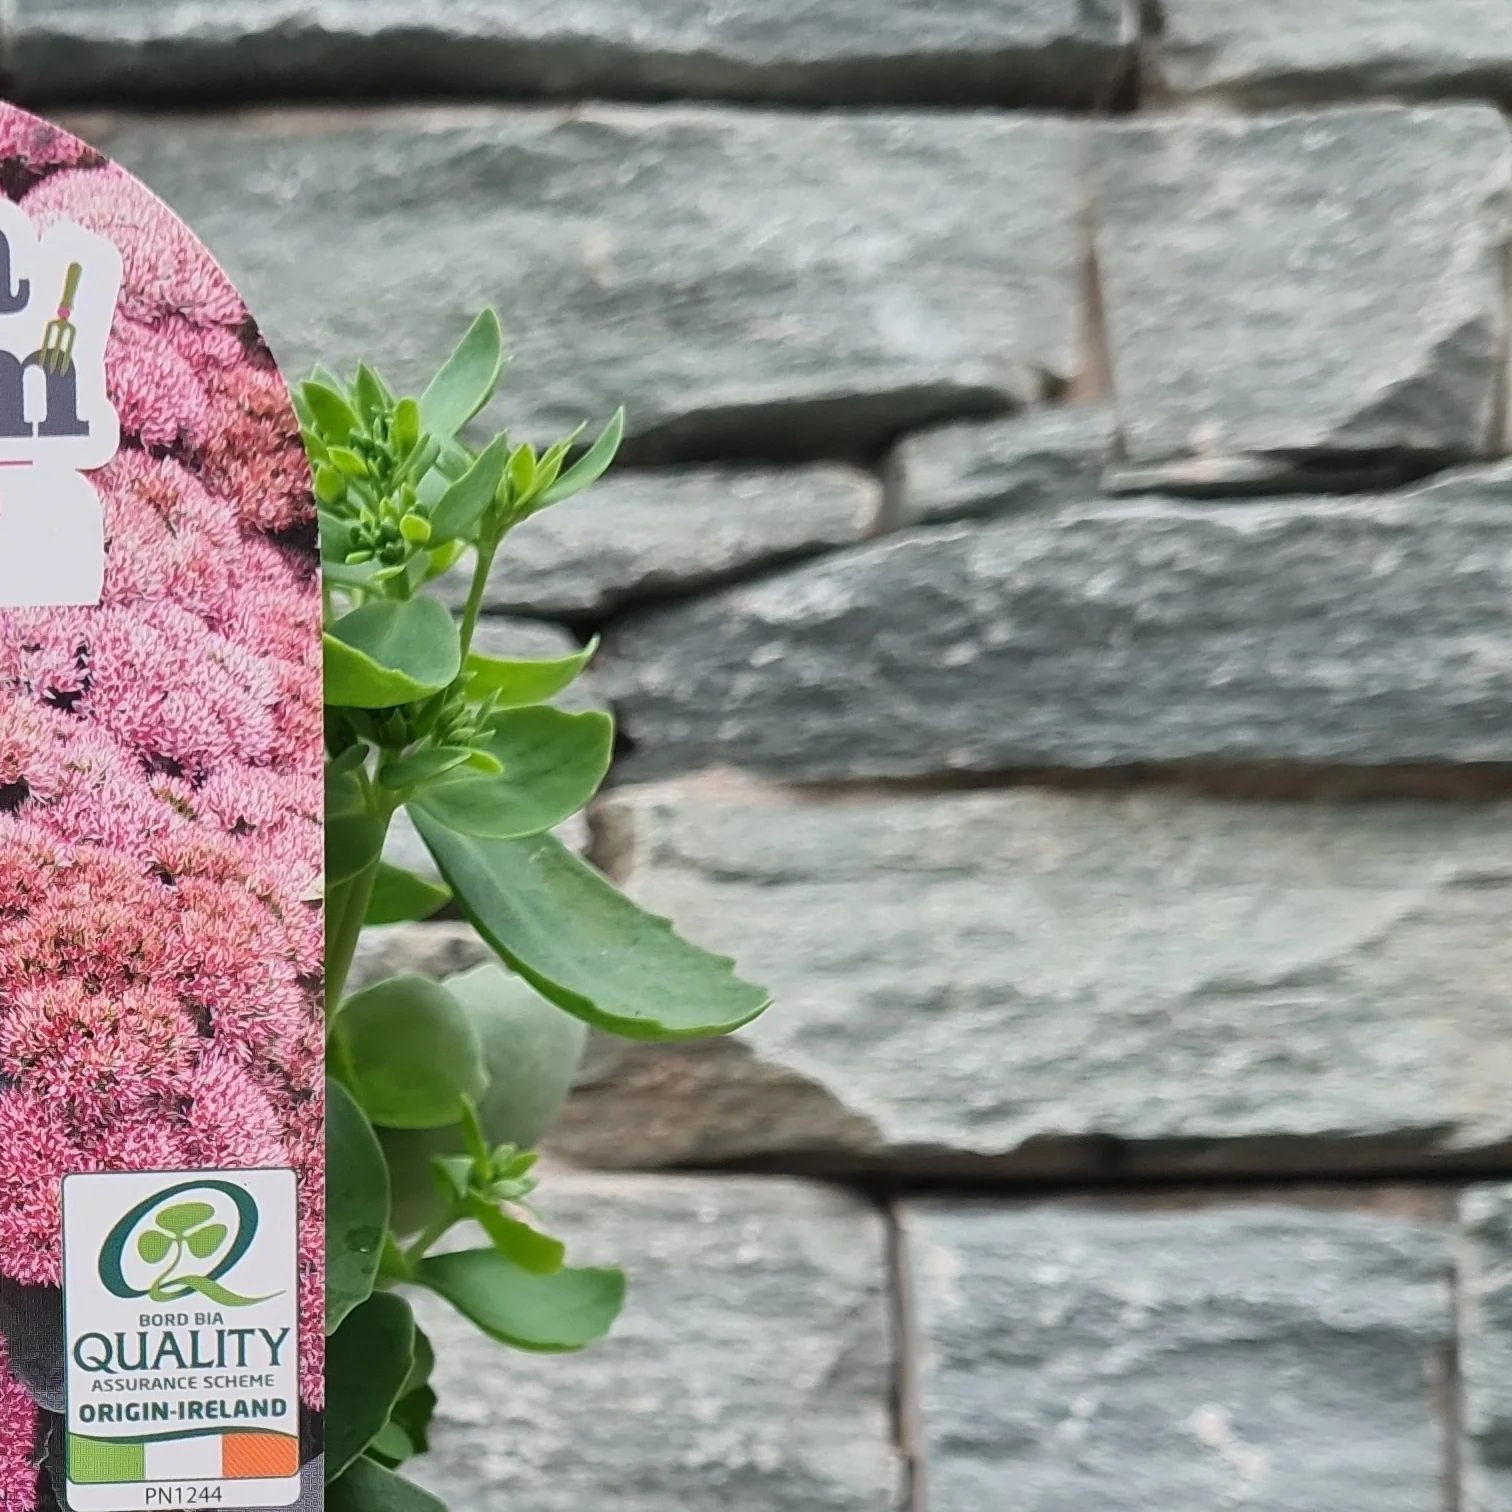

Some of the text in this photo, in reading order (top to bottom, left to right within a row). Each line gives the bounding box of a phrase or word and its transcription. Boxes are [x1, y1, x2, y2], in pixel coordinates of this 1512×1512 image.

[139, 1311, 224, 1327] BORD BIA
[73, 1327, 290, 1374] QUALITY
[91, 1374, 275, 1392] ASSURANCE SCHEME
[79, 1398, 287, 1422] ORIGIN-IRELAND
[145, 1486, 223, 1505] PN1244
